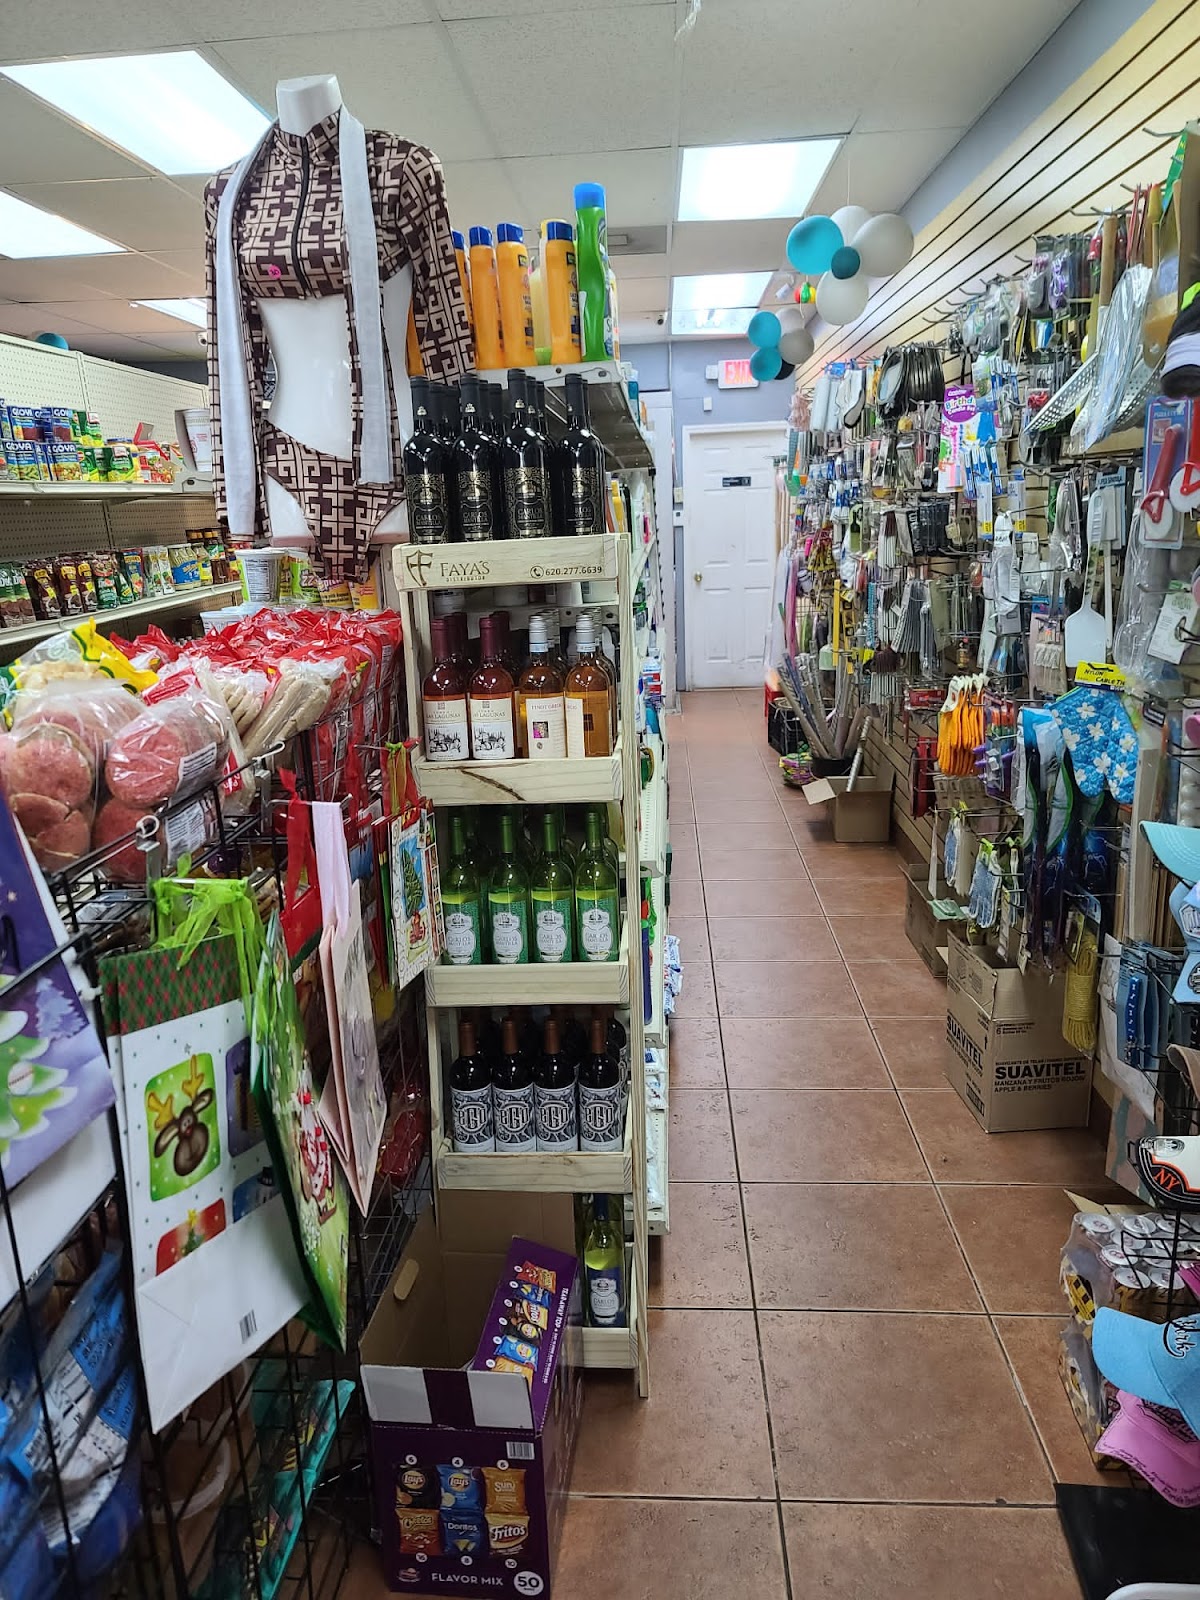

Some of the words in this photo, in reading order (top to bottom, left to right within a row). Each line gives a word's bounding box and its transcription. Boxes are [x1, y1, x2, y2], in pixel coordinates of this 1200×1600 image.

[5, 442, 32, 451] GOYA
[52, 444, 76, 453] GOYA
[545, 566, 602, 576] 620.277.6639
[995, 1062, 1085, 1080] SUAVITEL
[1153, 1168, 1180, 1191] NY
[447, 1522, 478, 1531] Doritos
[491, 1525, 525, 1541] Fritos
[431, 1573, 478, 1584] FLAVOR
[481, 1577, 504, 1586] MIX
[517, 1576, 540, 1588] 50
